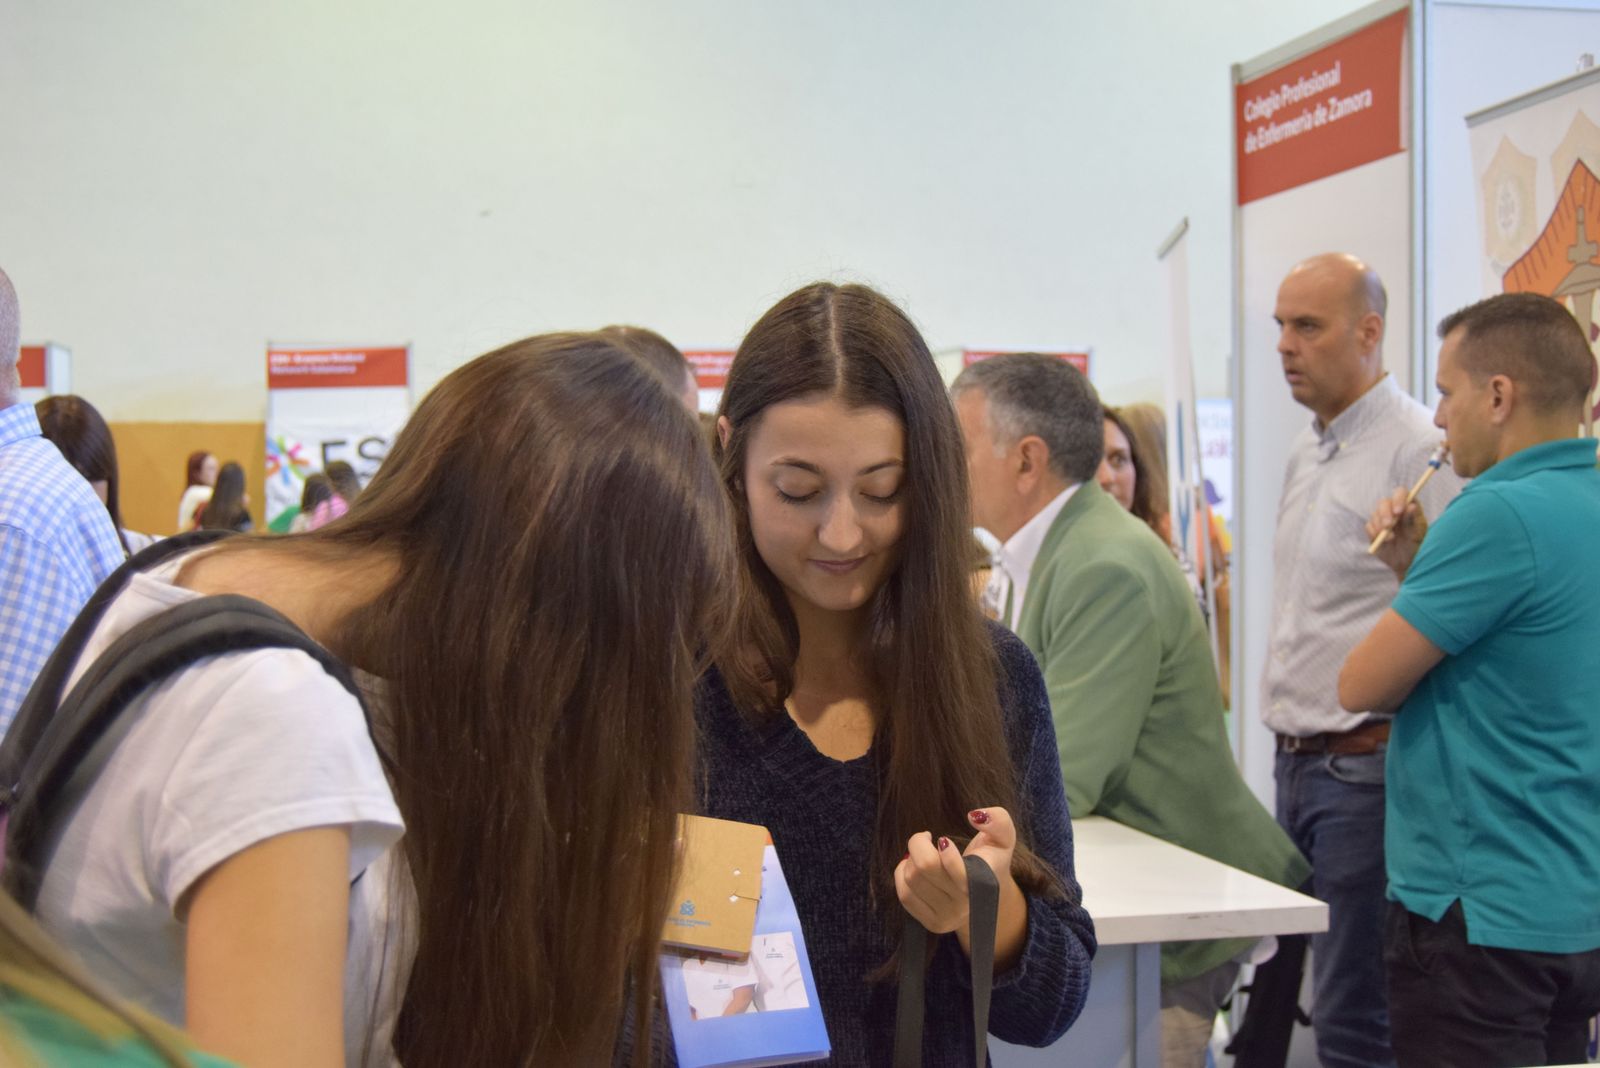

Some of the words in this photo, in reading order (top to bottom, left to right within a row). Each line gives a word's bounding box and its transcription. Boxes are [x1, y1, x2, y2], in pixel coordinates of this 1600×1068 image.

[1243, 90, 1281, 122] Colegio
[1281, 60, 1341, 106] Profesional
[1244, 131, 1257, 154] de
[1314, 102, 1327, 127] de
[1328, 88, 1373, 122] Zamora
